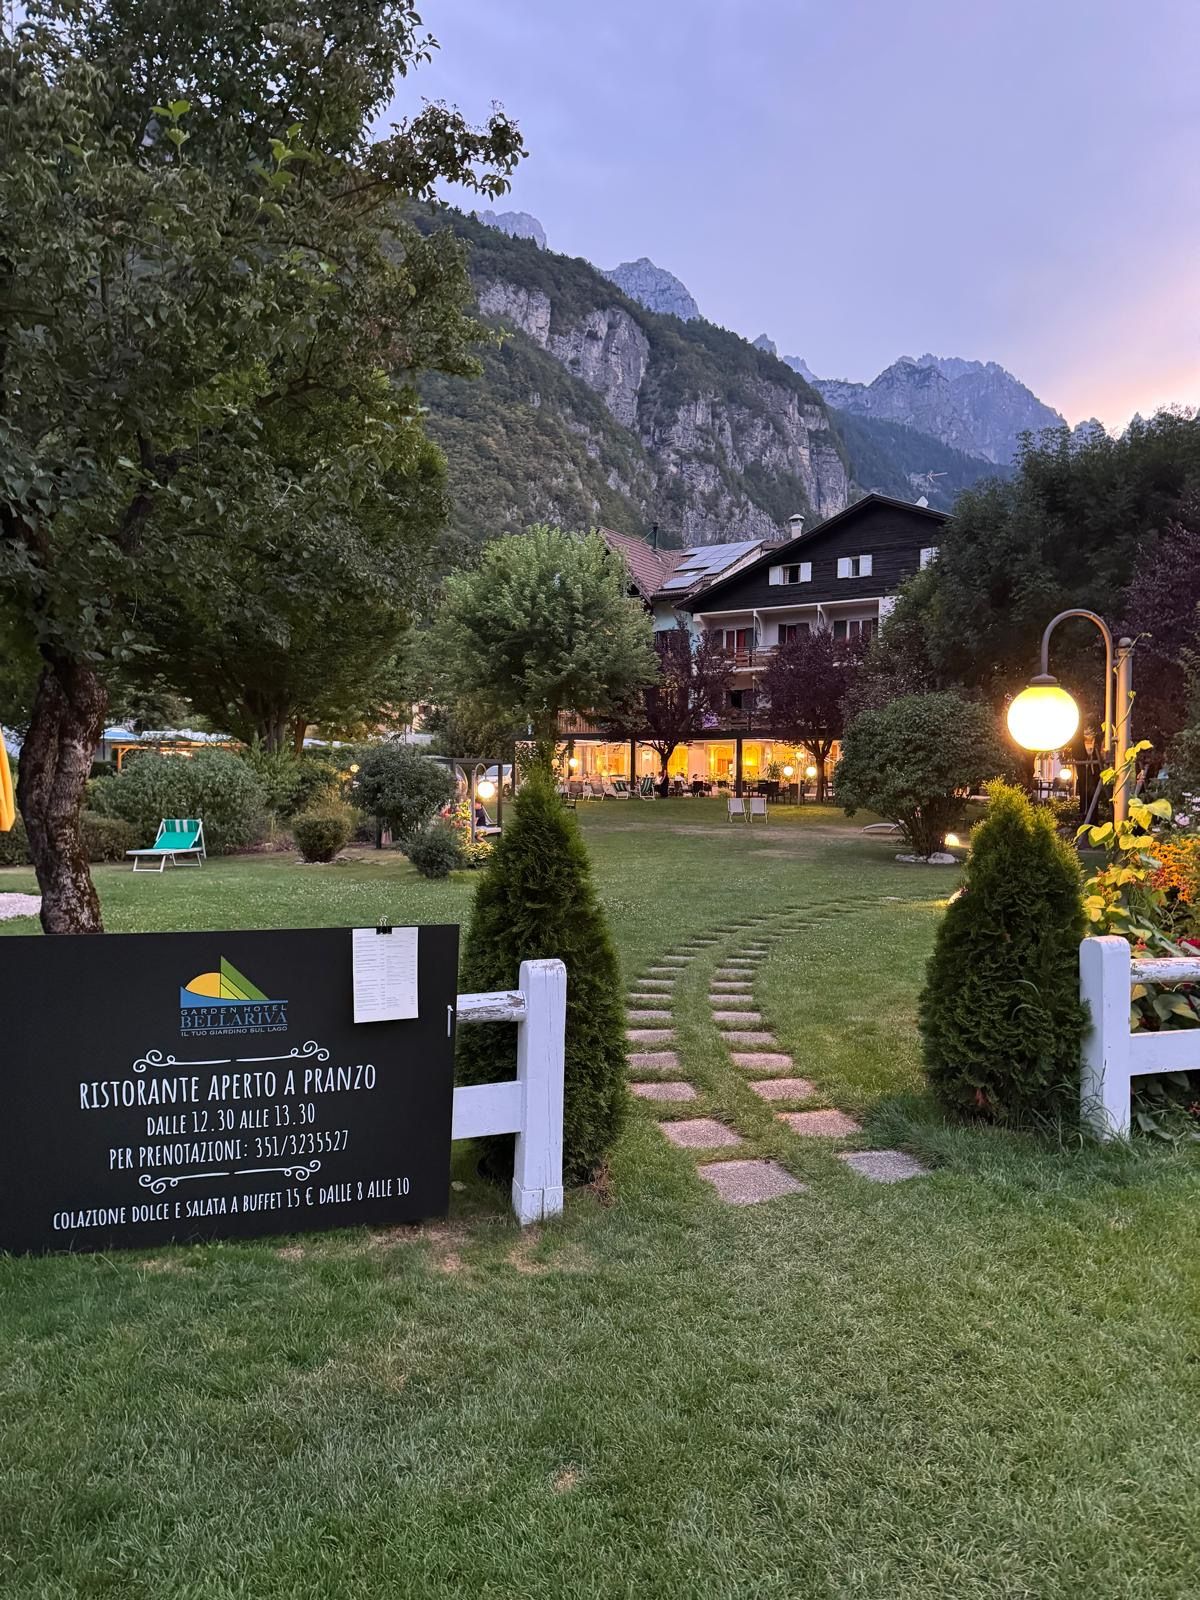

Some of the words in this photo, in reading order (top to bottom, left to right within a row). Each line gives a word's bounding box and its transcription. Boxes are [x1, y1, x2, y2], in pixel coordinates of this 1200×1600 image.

[181, 1007, 237, 1015] GARDEN
[244, 1004, 287, 1012] HOTEL
[181, 1012, 287, 1028] BELLARIVA
[210, 1028, 247, 1036] GIARDINO
[80, 1076, 200, 1110] RISTORANTE
[208, 1071, 276, 1101] APERTO
[284, 1069, 295, 1096] A
[304, 1064, 376, 1095] PRANZO
[147, 1115, 187, 1136] DALLE
[191, 1109, 235, 1133] 12.30
[239, 1109, 269, 1130] ALLE
[274, 1103, 315, 1127] 13.30
[109, 1148, 134, 1170] PER
[139, 1139, 248, 1168] PRENOTAZIONI:
[255, 1130, 349, 1158] 351/3235527
[53, 1207, 126, 1230] COLAZIONE
[132, 1203, 169, 1223] DOLCE
[175, 1202, 181, 1219] E
[185, 1198, 227, 1217] SALATA
[230, 1196, 238, 1213] A
[242, 1192, 282, 1212] BUFFET
[286, 1188, 300, 1208] 15
[305, 1187, 314, 1206] €
[319, 1183, 352, 1205] DALLE
[357, 1181, 363, 1201] 8
[367, 1179, 393, 1199] ALLE
[396, 1177, 410, 1196] 10
